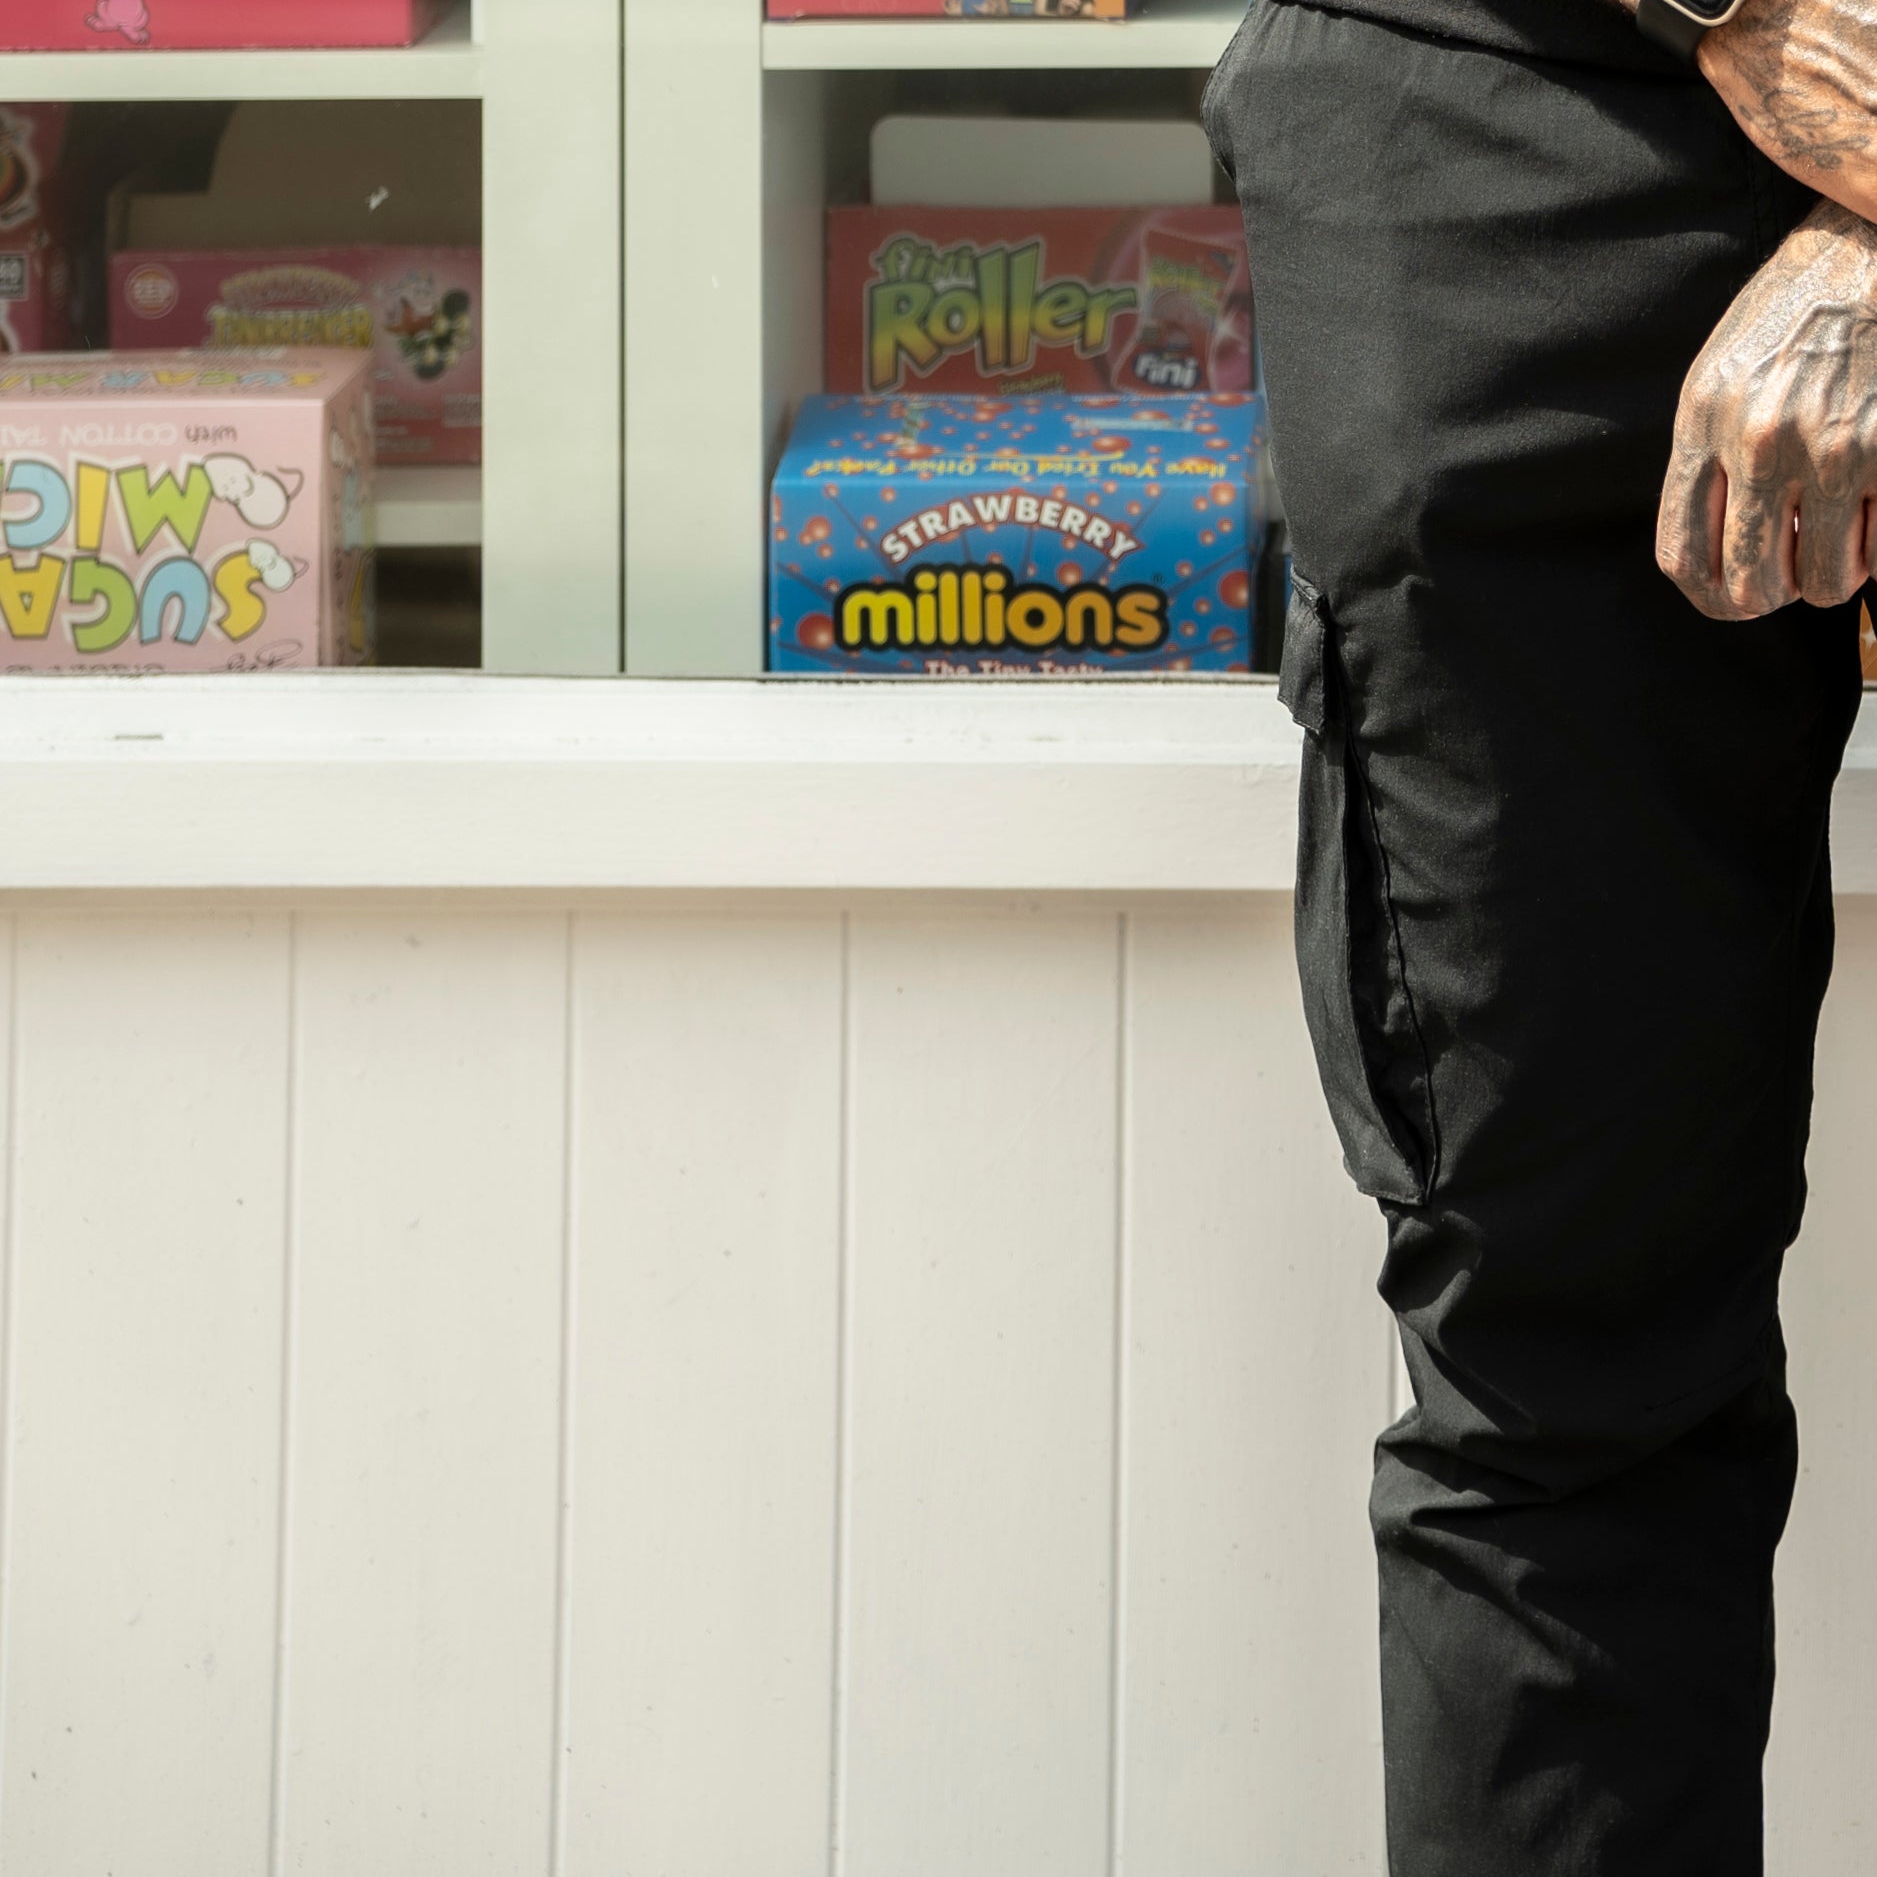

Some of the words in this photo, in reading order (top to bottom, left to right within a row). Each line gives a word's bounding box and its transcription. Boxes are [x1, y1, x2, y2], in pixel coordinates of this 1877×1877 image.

[868, 241, 1139, 393] Roller
[918, 457, 978, 477] Other
[989, 457, 1028, 476] Our
[1036, 456, 1099, 479] Tried
[1109, 459, 1157, 477] You
[1166, 459, 1228, 477] Have
[879, 493, 1140, 565] STRAWBERRY
[841, 570, 1166, 646] millions
